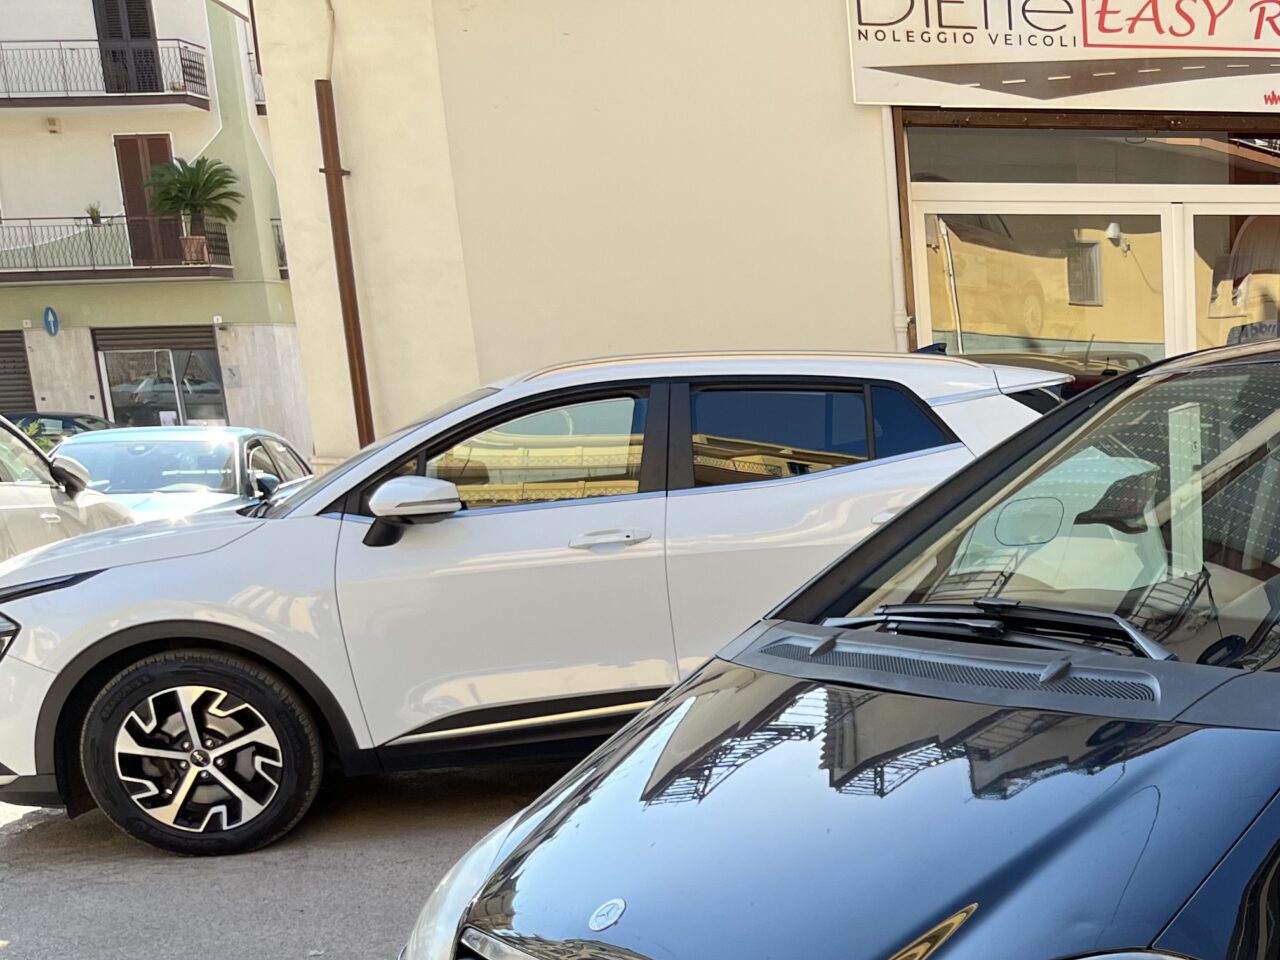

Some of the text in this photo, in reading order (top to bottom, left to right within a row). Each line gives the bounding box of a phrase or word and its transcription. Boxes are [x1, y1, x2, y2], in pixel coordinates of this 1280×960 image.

[1095, 0, 1234, 37] EASY
[858, 29, 1077, 47] NOLEGGIO VEICOLI
